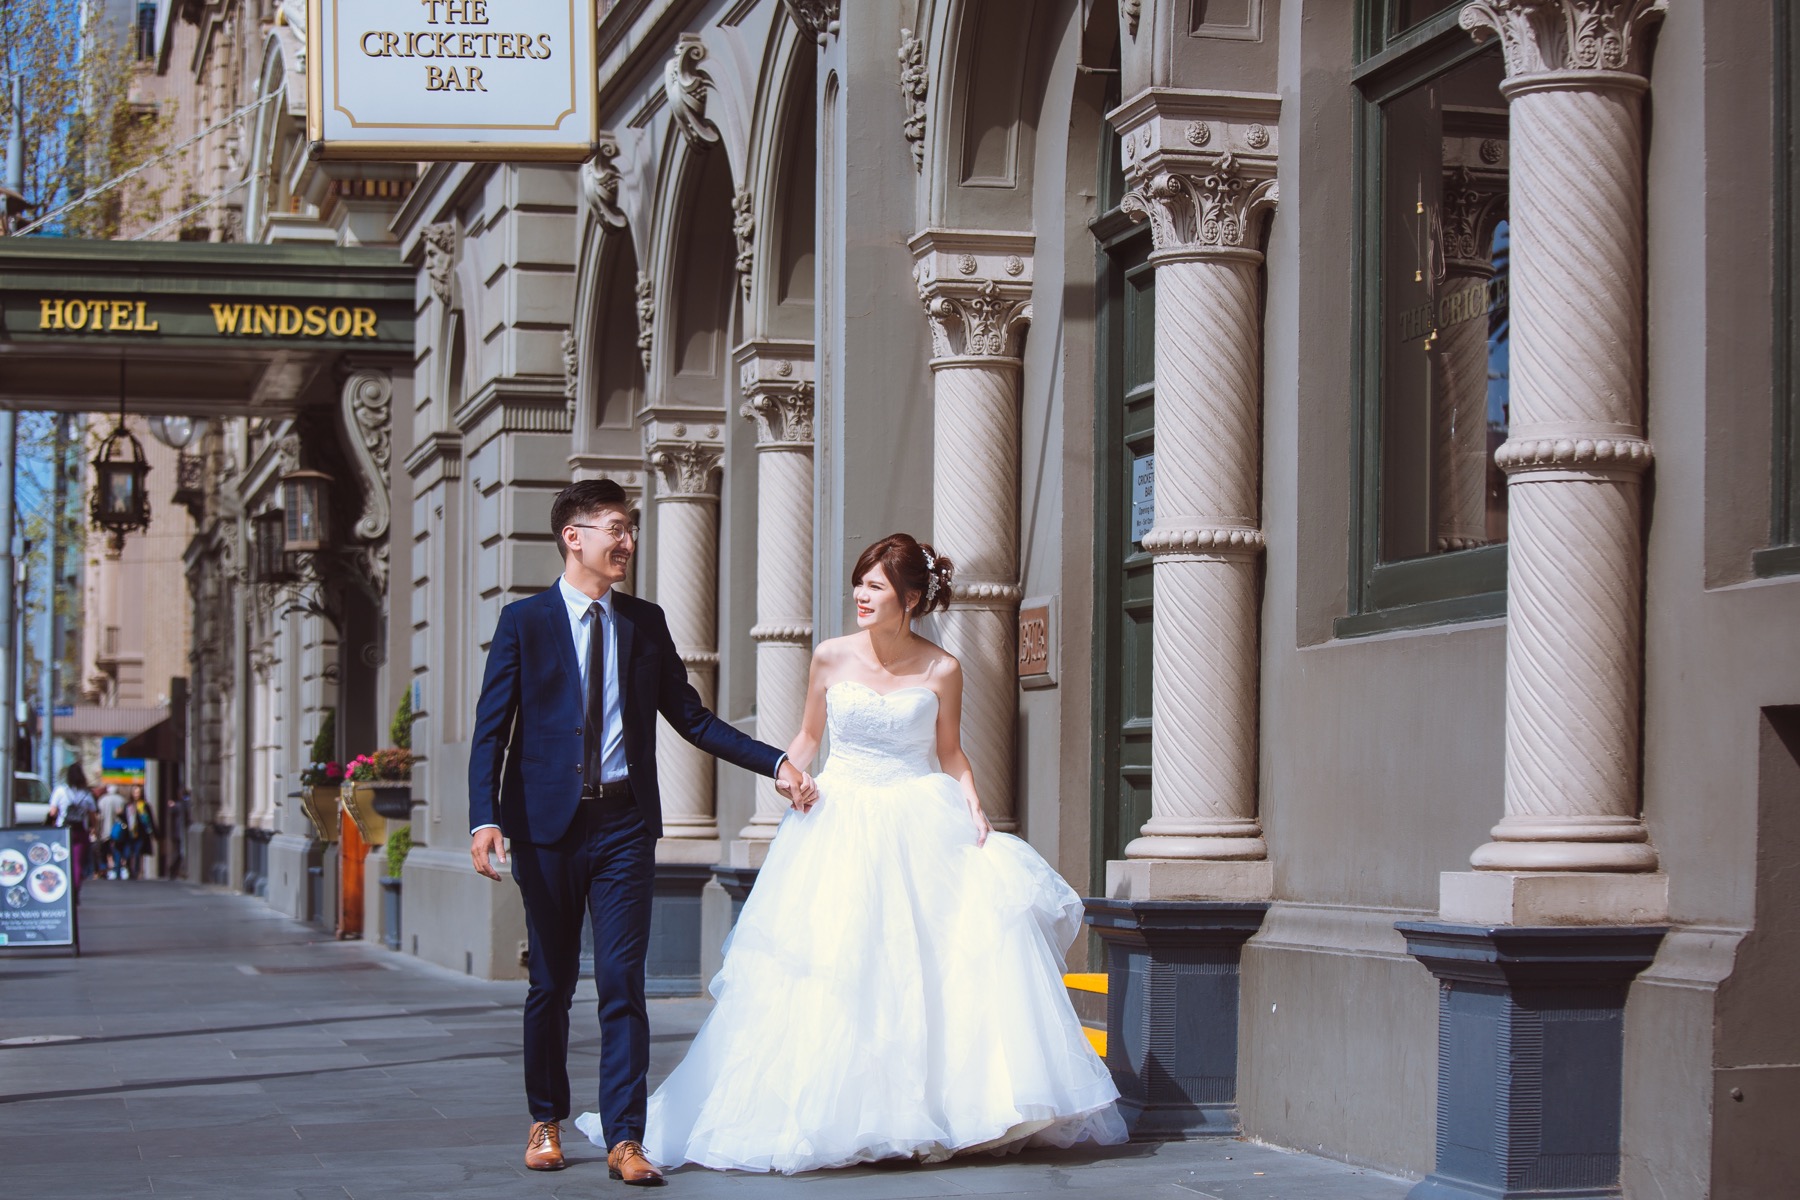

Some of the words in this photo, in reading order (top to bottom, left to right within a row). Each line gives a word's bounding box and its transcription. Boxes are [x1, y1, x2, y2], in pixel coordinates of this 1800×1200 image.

[421, 0, 490, 24] THE
[359, 31, 552, 60] CRICKETERS
[425, 65, 488, 92] BAR
[39, 299, 159, 332] HOTEL
[209, 303, 377, 337] WINDSOR
[1400, 301, 1434, 343] THE
[1146, 459, 1154, 470] THE
